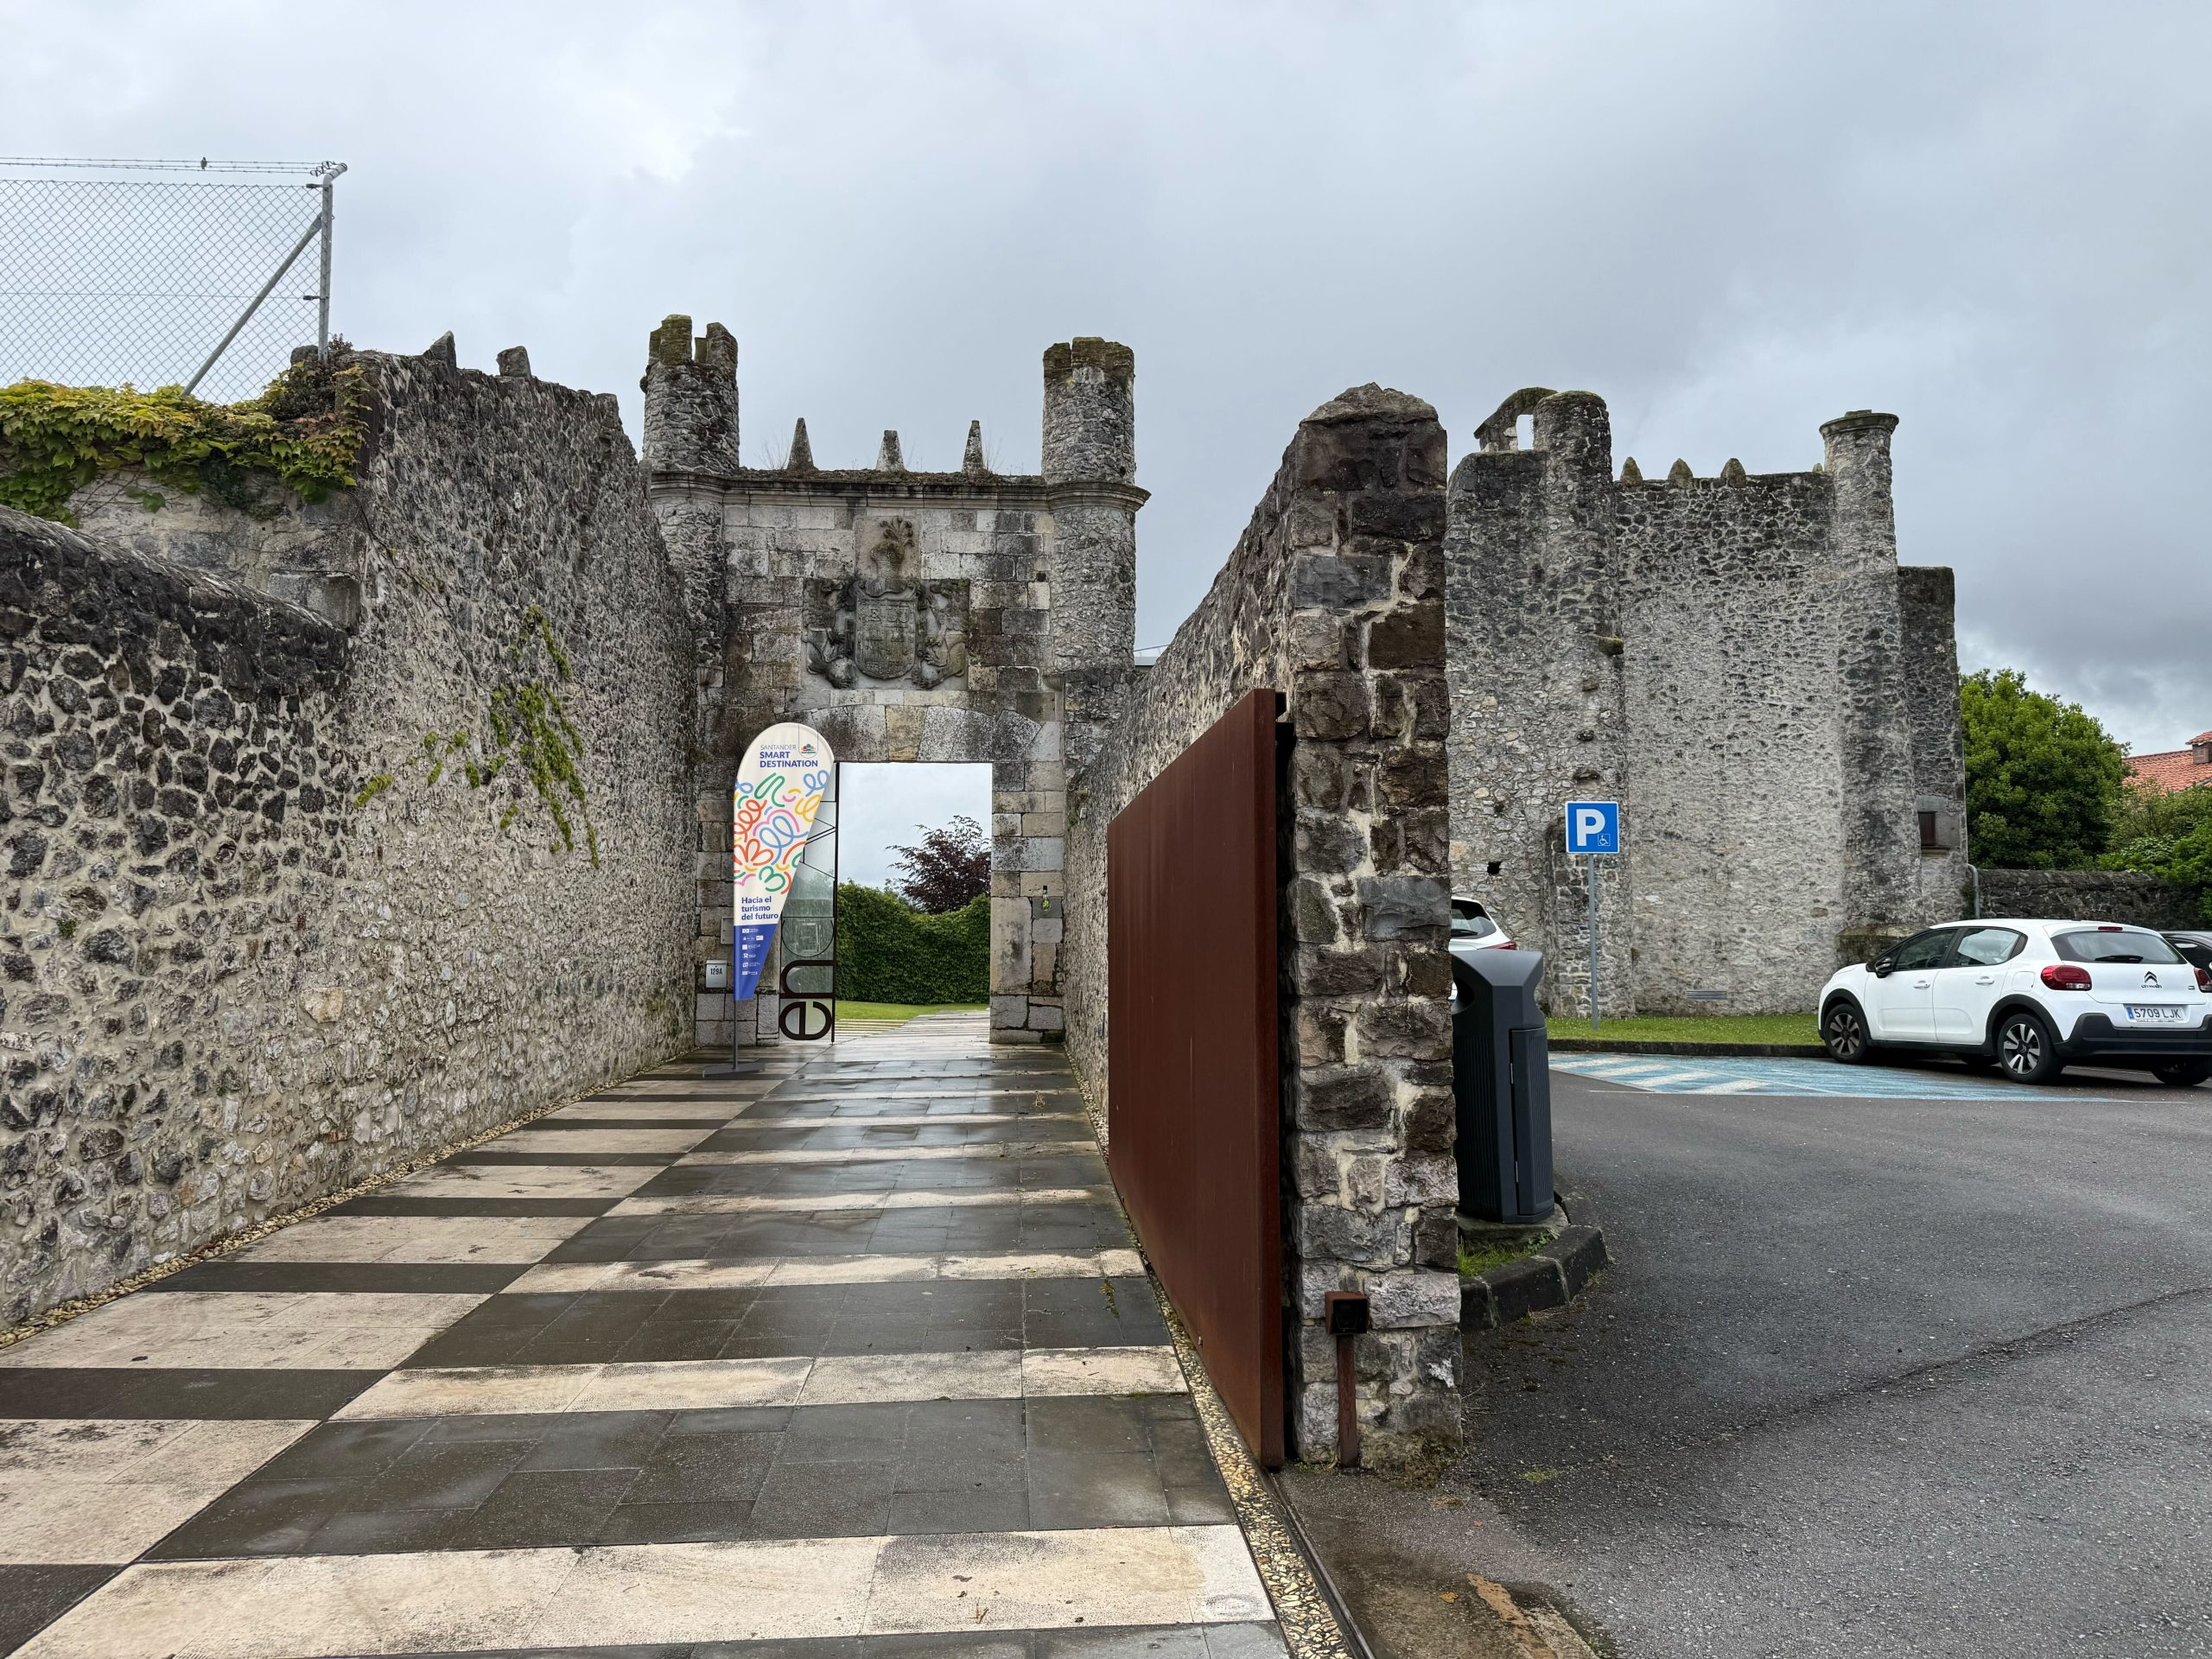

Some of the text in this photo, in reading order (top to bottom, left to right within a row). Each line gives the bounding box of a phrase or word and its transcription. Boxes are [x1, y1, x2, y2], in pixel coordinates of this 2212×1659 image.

[760, 760, 818, 768] DESTINATION
[1576, 809, 1605, 847] P
[2134, 1008, 2182, 1019] 5709 LJK
